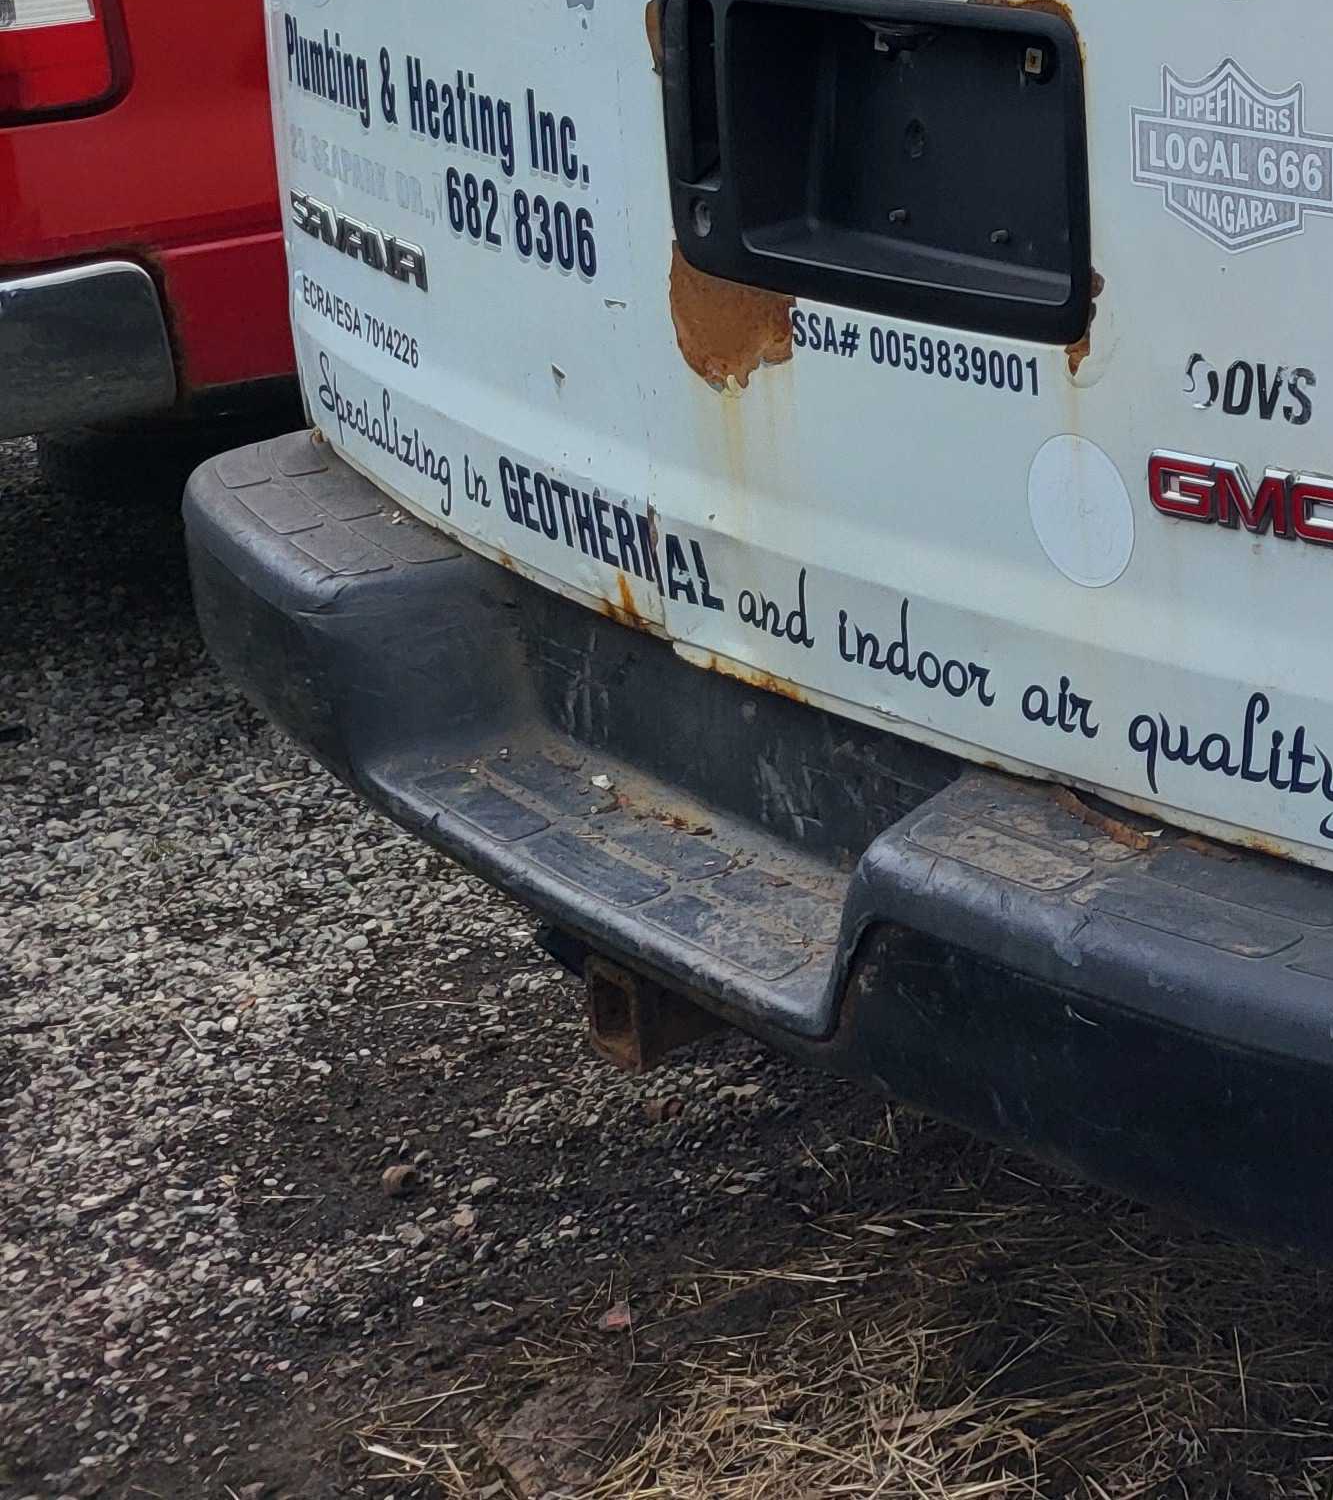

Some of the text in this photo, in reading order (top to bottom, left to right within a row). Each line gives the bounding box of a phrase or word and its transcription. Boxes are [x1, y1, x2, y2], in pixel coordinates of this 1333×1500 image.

[285, 12, 591, 184] Plumbing & Heating Inc.
[1174, 76, 1291, 134] PIPEFITTERS
[1149, 129, 1324, 193] LOCAL 666
[289, 186, 429, 293] SAVANA
[446, 166, 502, 248] 682
[513, 188, 598, 279] 8306
[1187, 188, 1278, 234] NIAGARA
[364, 312, 419, 370] 7014226
[869, 324, 1041, 397] 0059839001
[317, 351, 453, 517] Specializing
[464, 457, 492, 509] in
[498, 455, 724, 613] GEOTHERMAL
[738, 566, 816, 649] and
[837, 597, 996, 708] indoor
[1020, 676, 1101, 740] air
